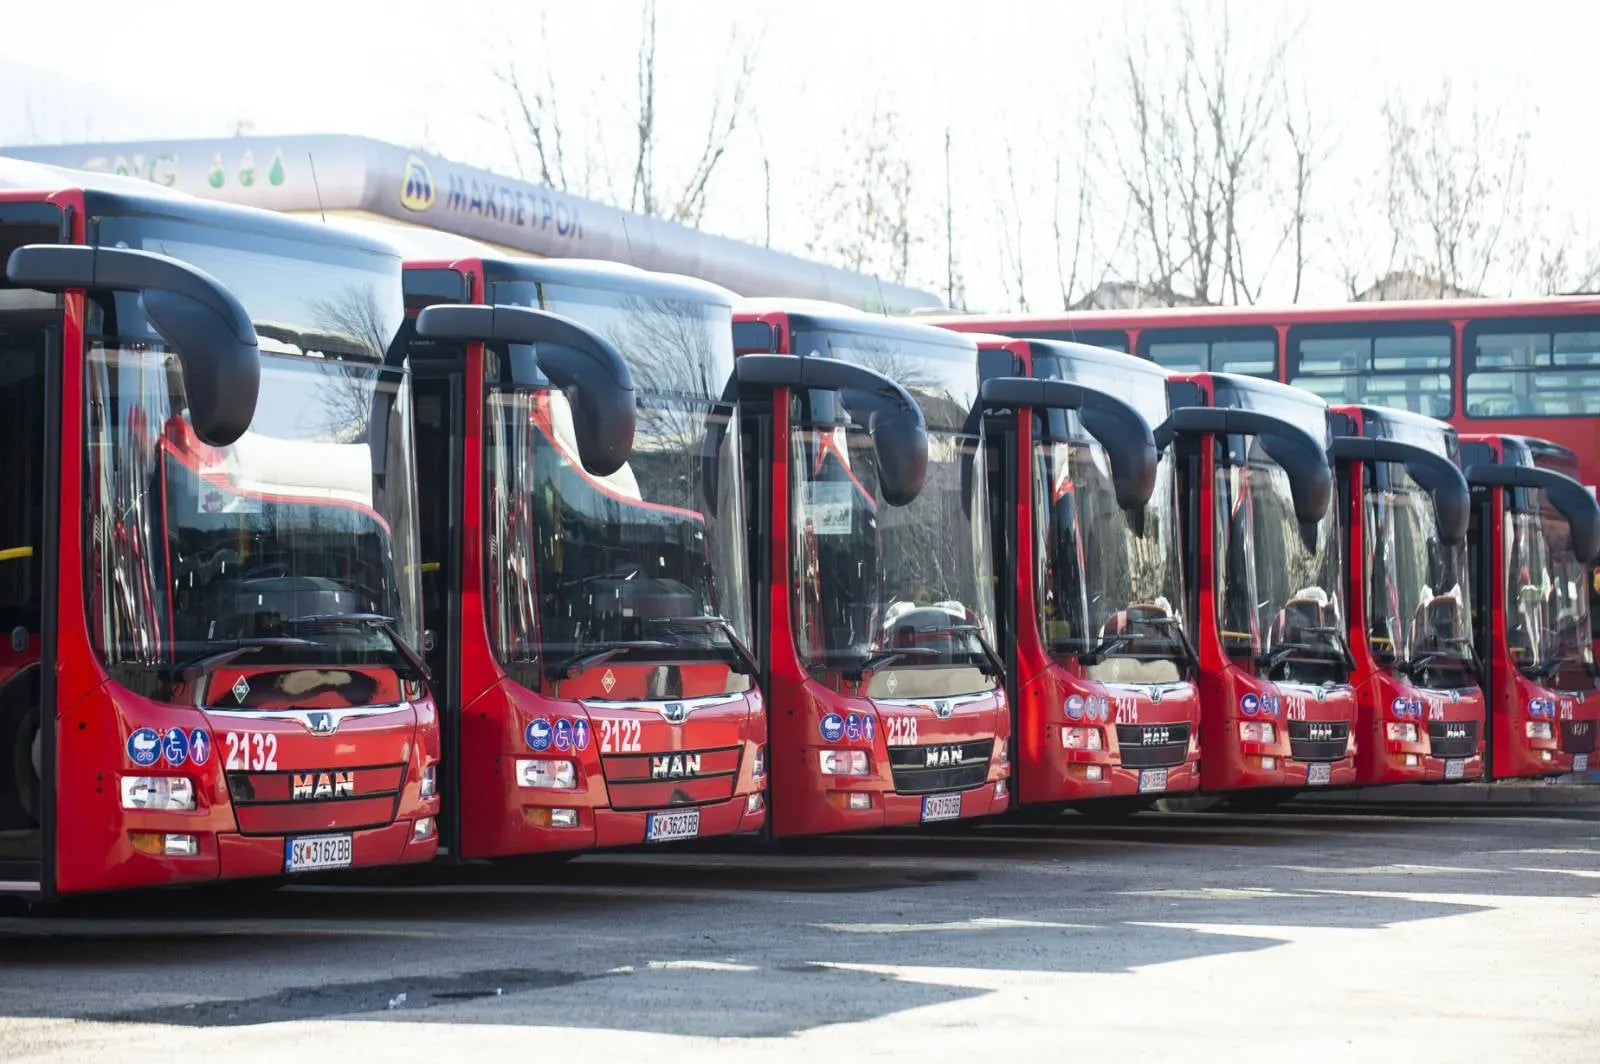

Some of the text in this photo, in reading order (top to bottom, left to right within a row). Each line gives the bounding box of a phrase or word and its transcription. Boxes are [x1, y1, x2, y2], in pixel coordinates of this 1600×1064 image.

[447, 172, 583, 240] МАКПЕТРОЛ
[1115, 697, 1138, 724] 2114
[601, 719, 641, 752] 2122
[887, 716, 918, 746] 2128
[225, 731, 278, 771] 2132
[926, 746, 964, 768] MAN
[651, 754, 701, 779] MAN
[291, 771, 355, 800] MAN
[293, 839, 350, 864] SK 3162BB
